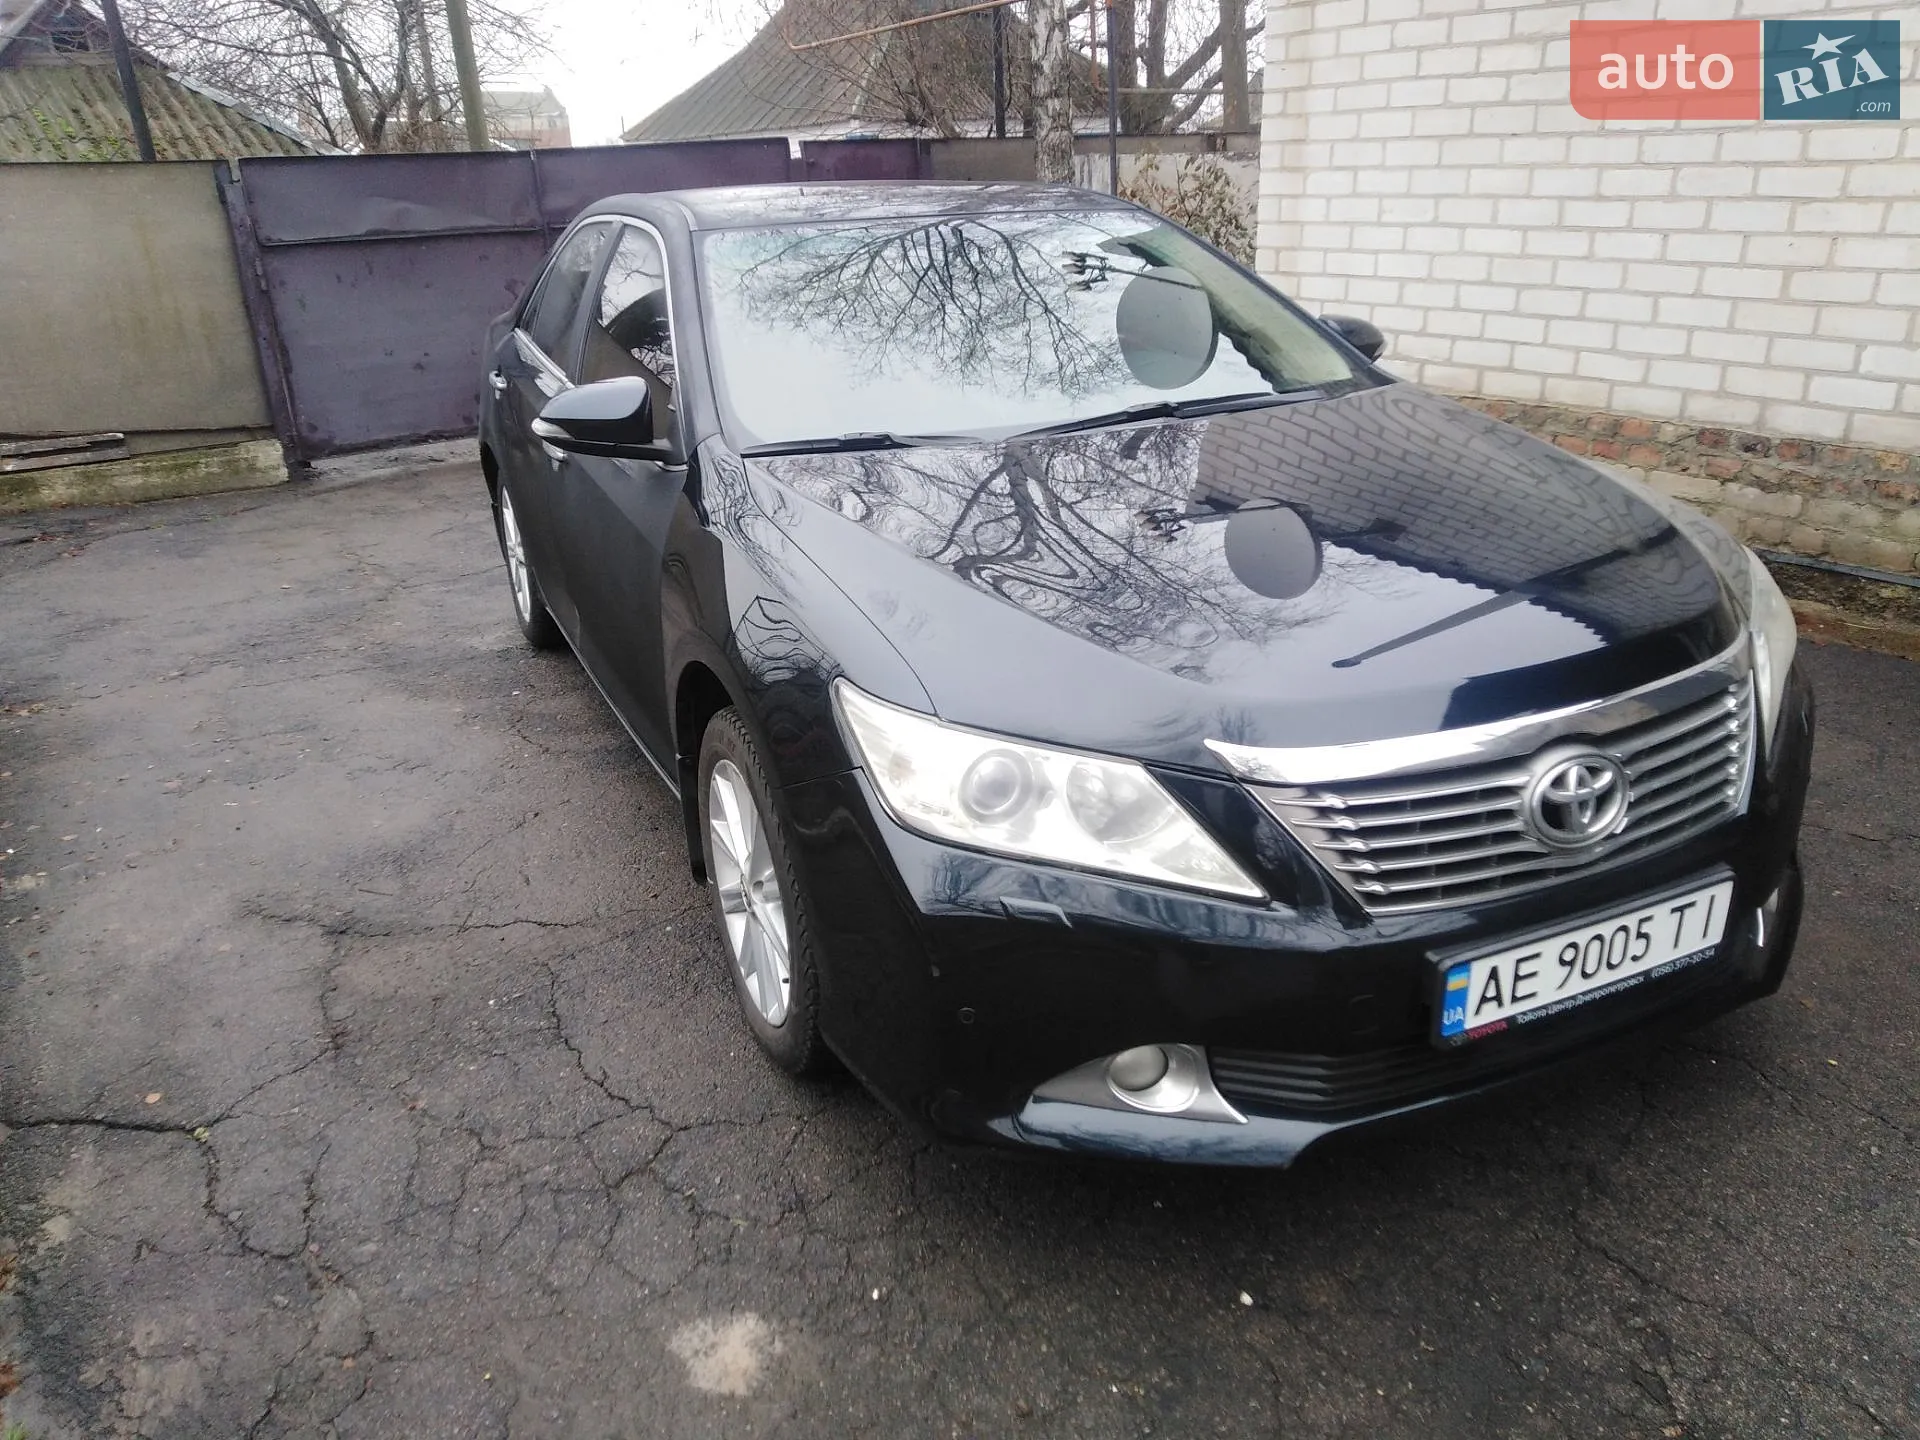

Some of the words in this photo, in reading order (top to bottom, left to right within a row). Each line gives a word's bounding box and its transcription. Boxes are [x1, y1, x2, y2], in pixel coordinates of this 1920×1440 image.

[1474, 952, 1542, 1016] AE
[1556, 914, 1654, 990] 9005
[1443, 1006, 1464, 1025] UA
[1465, 1020, 1508, 1039] TOYOTA
